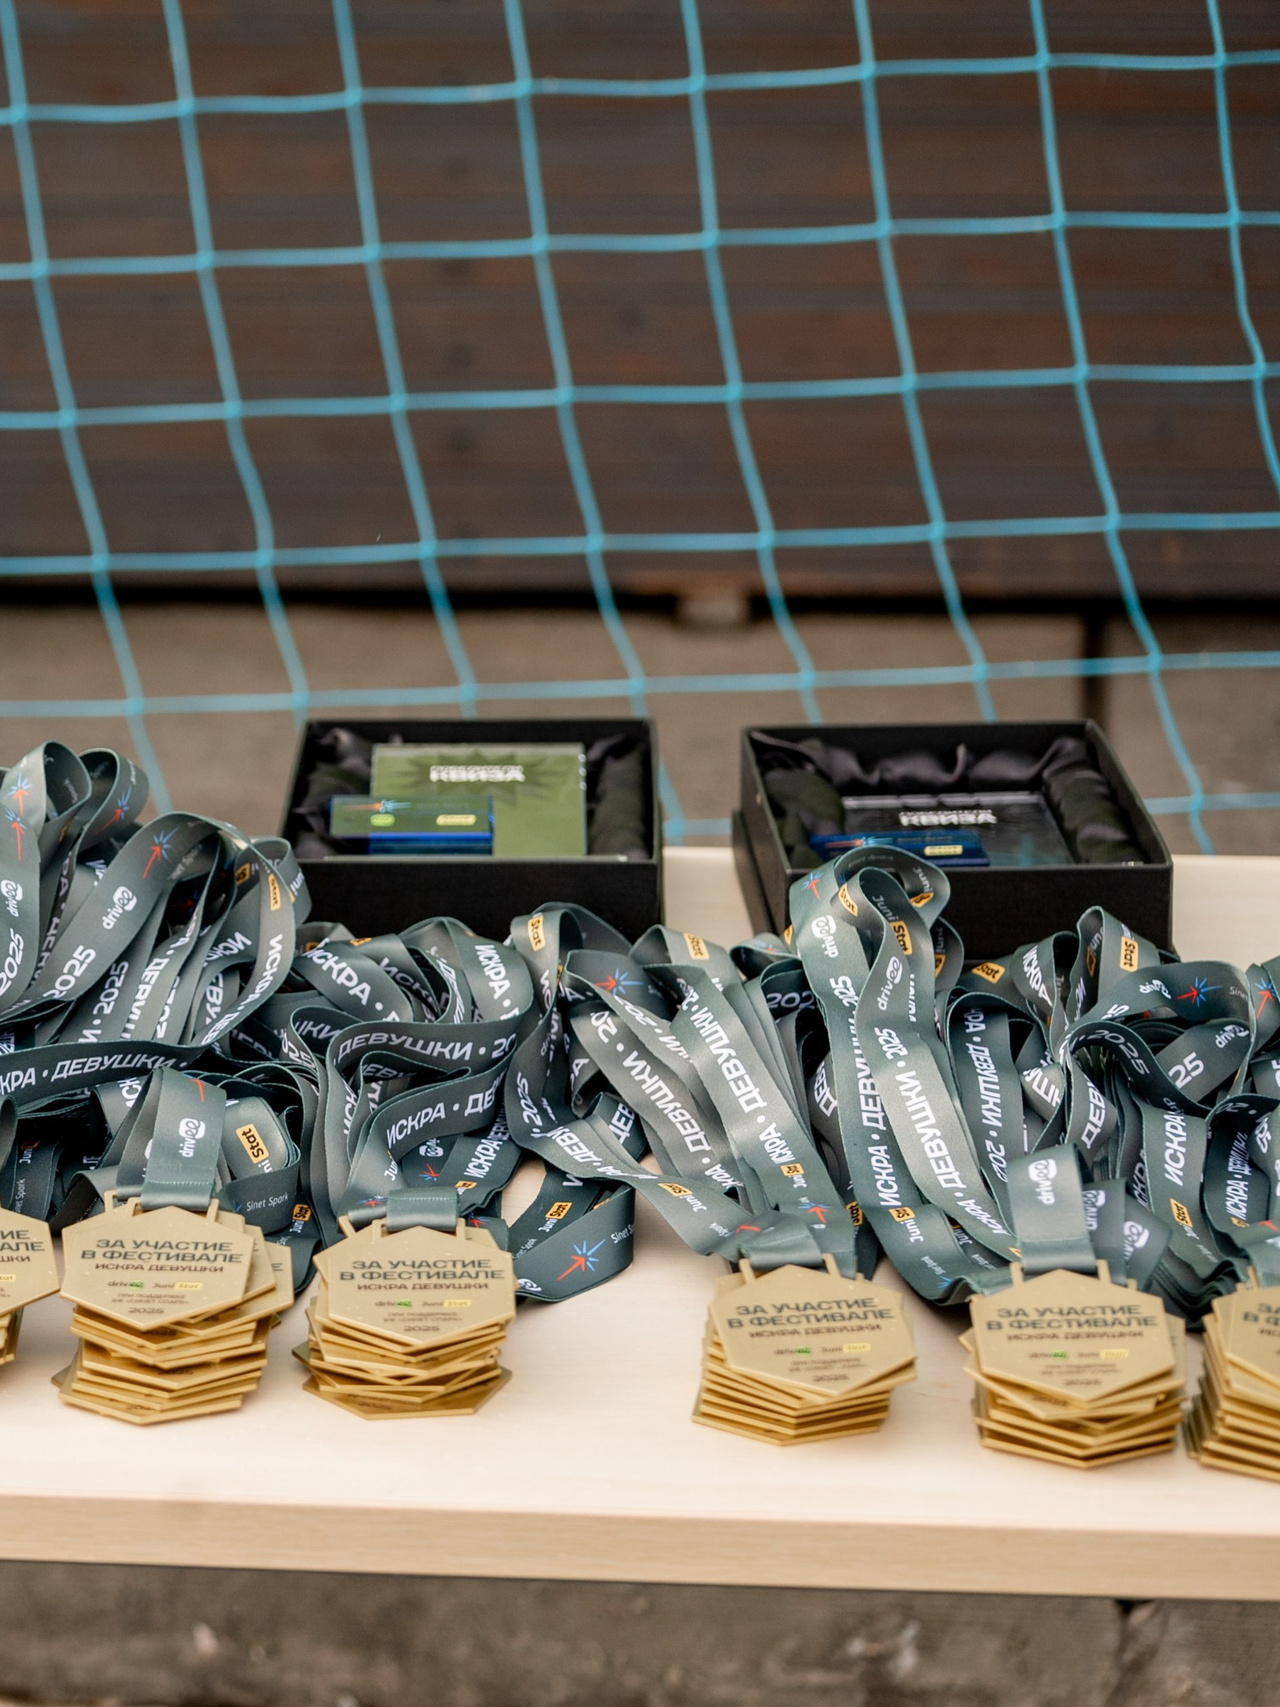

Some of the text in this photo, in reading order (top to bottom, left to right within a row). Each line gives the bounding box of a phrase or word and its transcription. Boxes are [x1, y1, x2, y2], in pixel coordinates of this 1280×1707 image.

[0, 879, 23, 918] drivee
[102, 886, 138, 930] drivee
[530, 918, 542, 947] Stat
[812, 915, 838, 958] drivee
[872, 895, 909, 952] Juni Stat
[43, 945, 97, 998] 2025
[302, 938, 372, 1006] ИСКРА
[475, 944, 511, 1000] ИСКРА
[975, 962, 1002, 981] Stat
[1122, 941, 1135, 967] Stat
[94, 960, 129, 1014] 2025
[877, 956, 903, 1011] drivee
[1022, 945, 1053, 1007] ИСКРА
[51, 1053, 176, 1081] ДЕВУШКИ
[334, 1032, 473, 1066] ДЕВУШКИ
[690, 1007, 767, 1112] ДЕВУШКИ
[1093, 1029, 1150, 1076] 2025
[517, 1072, 543, 1127] 2025
[623, 1050, 711, 1155] ДЕВУШКИ
[966, 1043, 1003, 1127] ДЕВУШКИ
[387, 1102, 445, 1149] ИСКРА
[875, 1027, 966, 1189] ДЕВУШКИ 2025
[178, 1117, 206, 1158] drivee
[241, 1128, 264, 1159] Stat
[1164, 1112, 1186, 1186] ИСКРА
[464, 1138, 503, 1179] ИСКРА
[868, 1145, 902, 1207] ИСКРА
[246, 1192, 289, 1212] Sinet Spark
[1028, 1158, 1057, 1206] drivee
[1227, 1180, 1248, 1220] ИСКРА
[680, 1195, 707, 1212] Juni
[538, 1217, 558, 1232] Juni
[901, 1219, 924, 1243] Juni
[81, 1250, 243, 1263] В ФЕСТИВАЛЕ
[96, 1239, 233, 1251] ЗА УЧАСТИЕ
[352, 1259, 492, 1269] ЗА УЧАСТИЕ
[95, 1263, 224, 1273] ИСКРА ДЕВУШКИ
[340, 1270, 506, 1281] В ФЕСТИВАЛЕ
[727, 1309, 895, 1329] В ФЕСТИВАЛЕ
[735, 1297, 878, 1316] ЗА УЧАСТИЕ
[987, 1316, 1158, 1330] В ФЕСТИВАЛЕ
[998, 1304, 1143, 1318] ЗА УЧАСТИЕ
